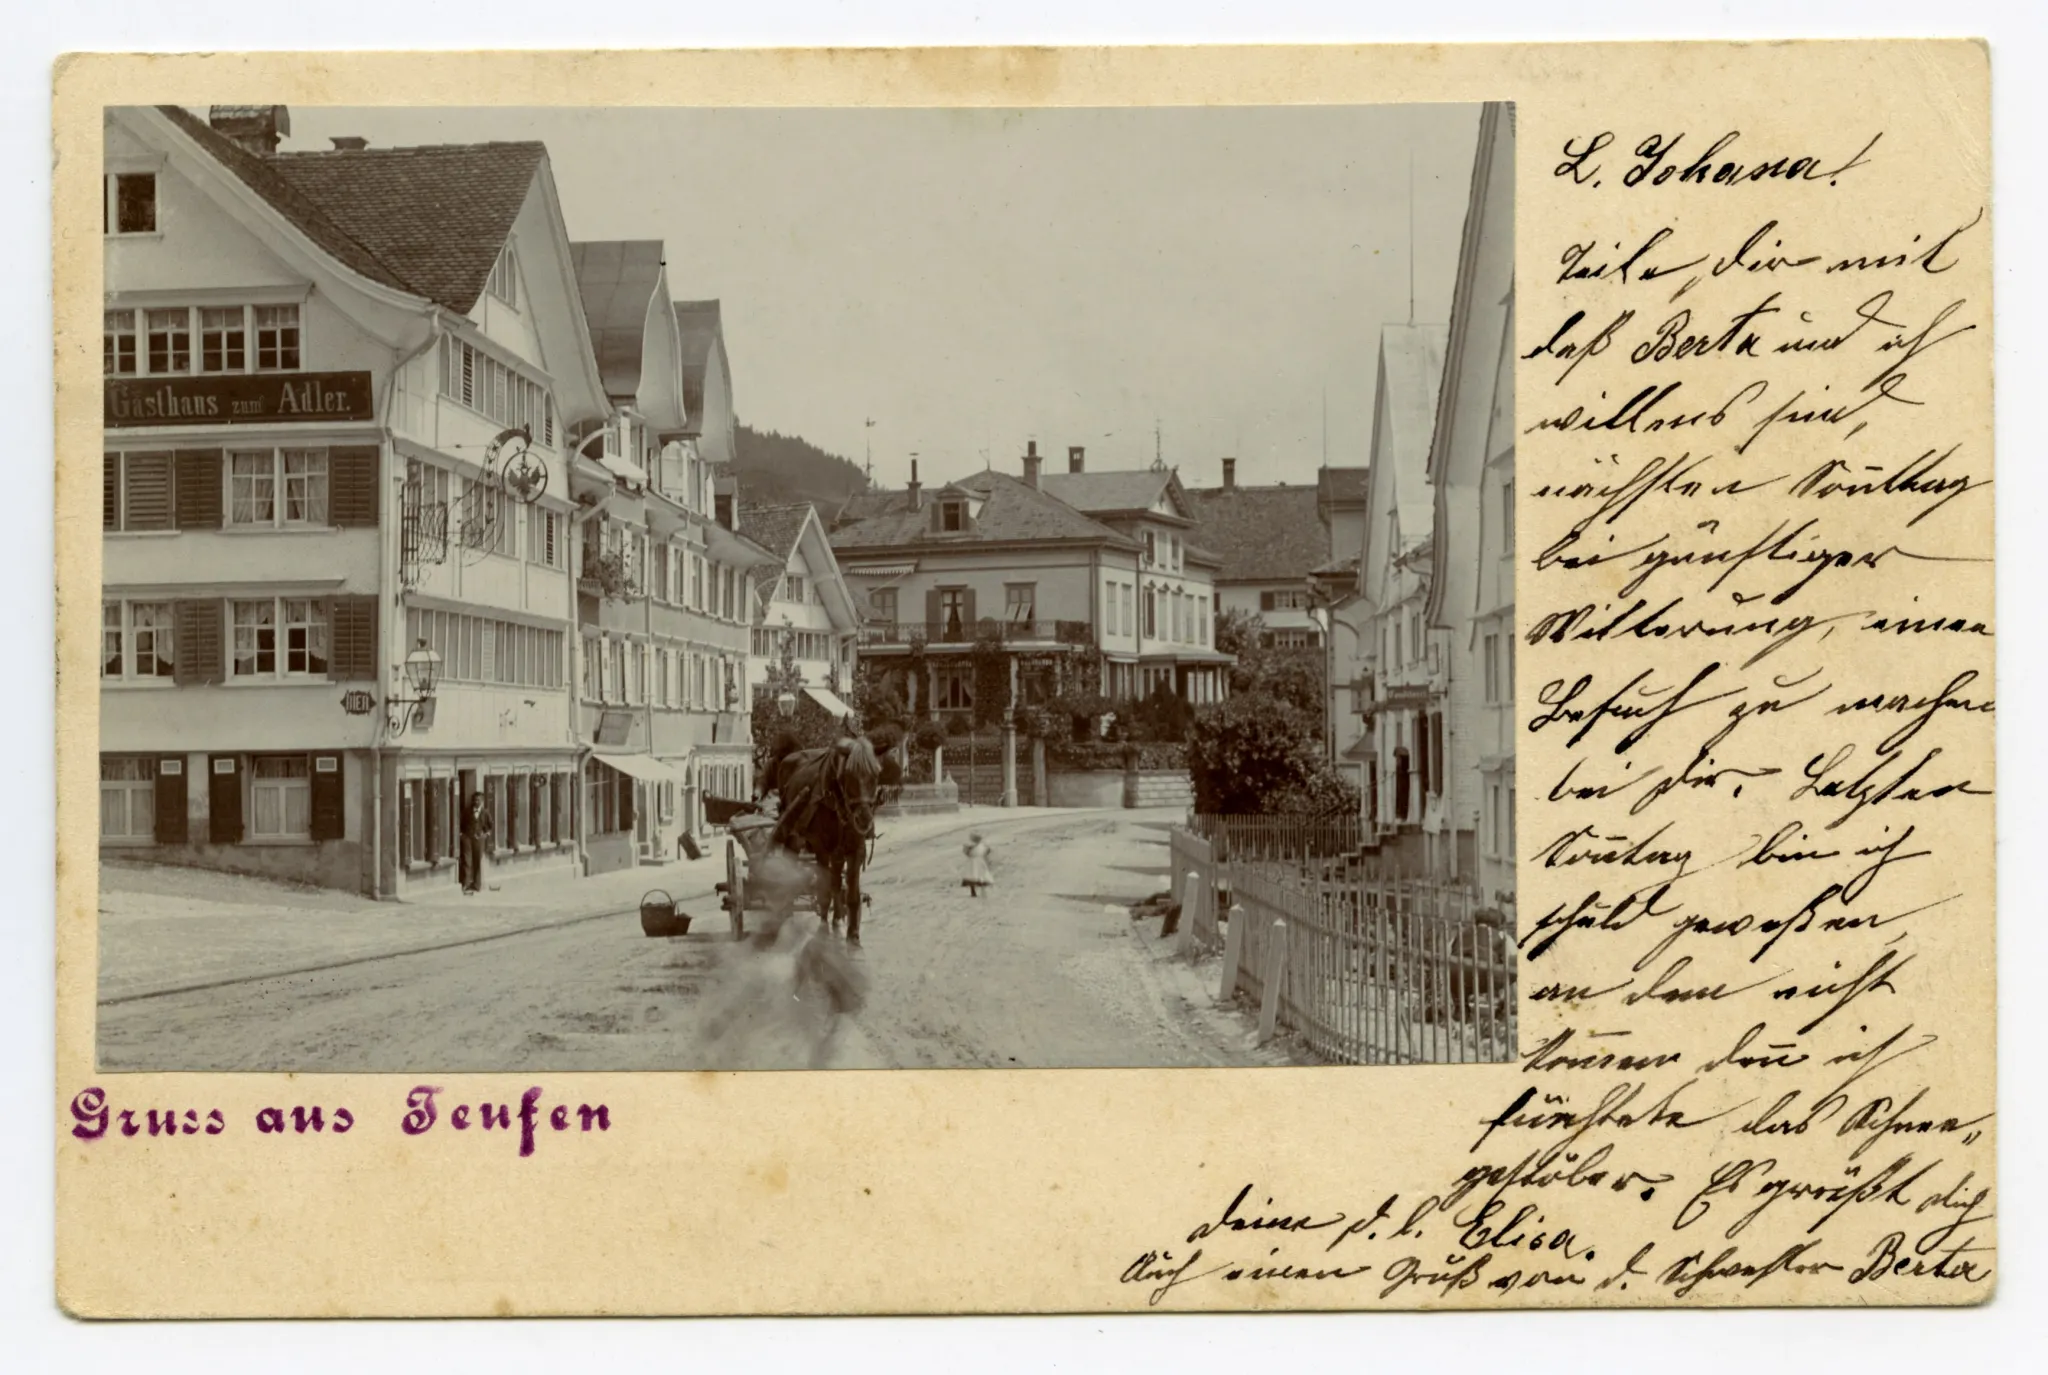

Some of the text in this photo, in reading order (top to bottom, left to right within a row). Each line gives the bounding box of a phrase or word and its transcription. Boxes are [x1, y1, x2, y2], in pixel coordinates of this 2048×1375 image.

[1825, 206, 1984, 274] mit
[1631, 292, 1781, 364] Berta
[1775, 291, 1907, 353] und
[1862, 299, 1977, 393] ich
[70, 1084, 612, 1158] Gruss aus Teufen
[1847, 1230, 1997, 1284] Berta
